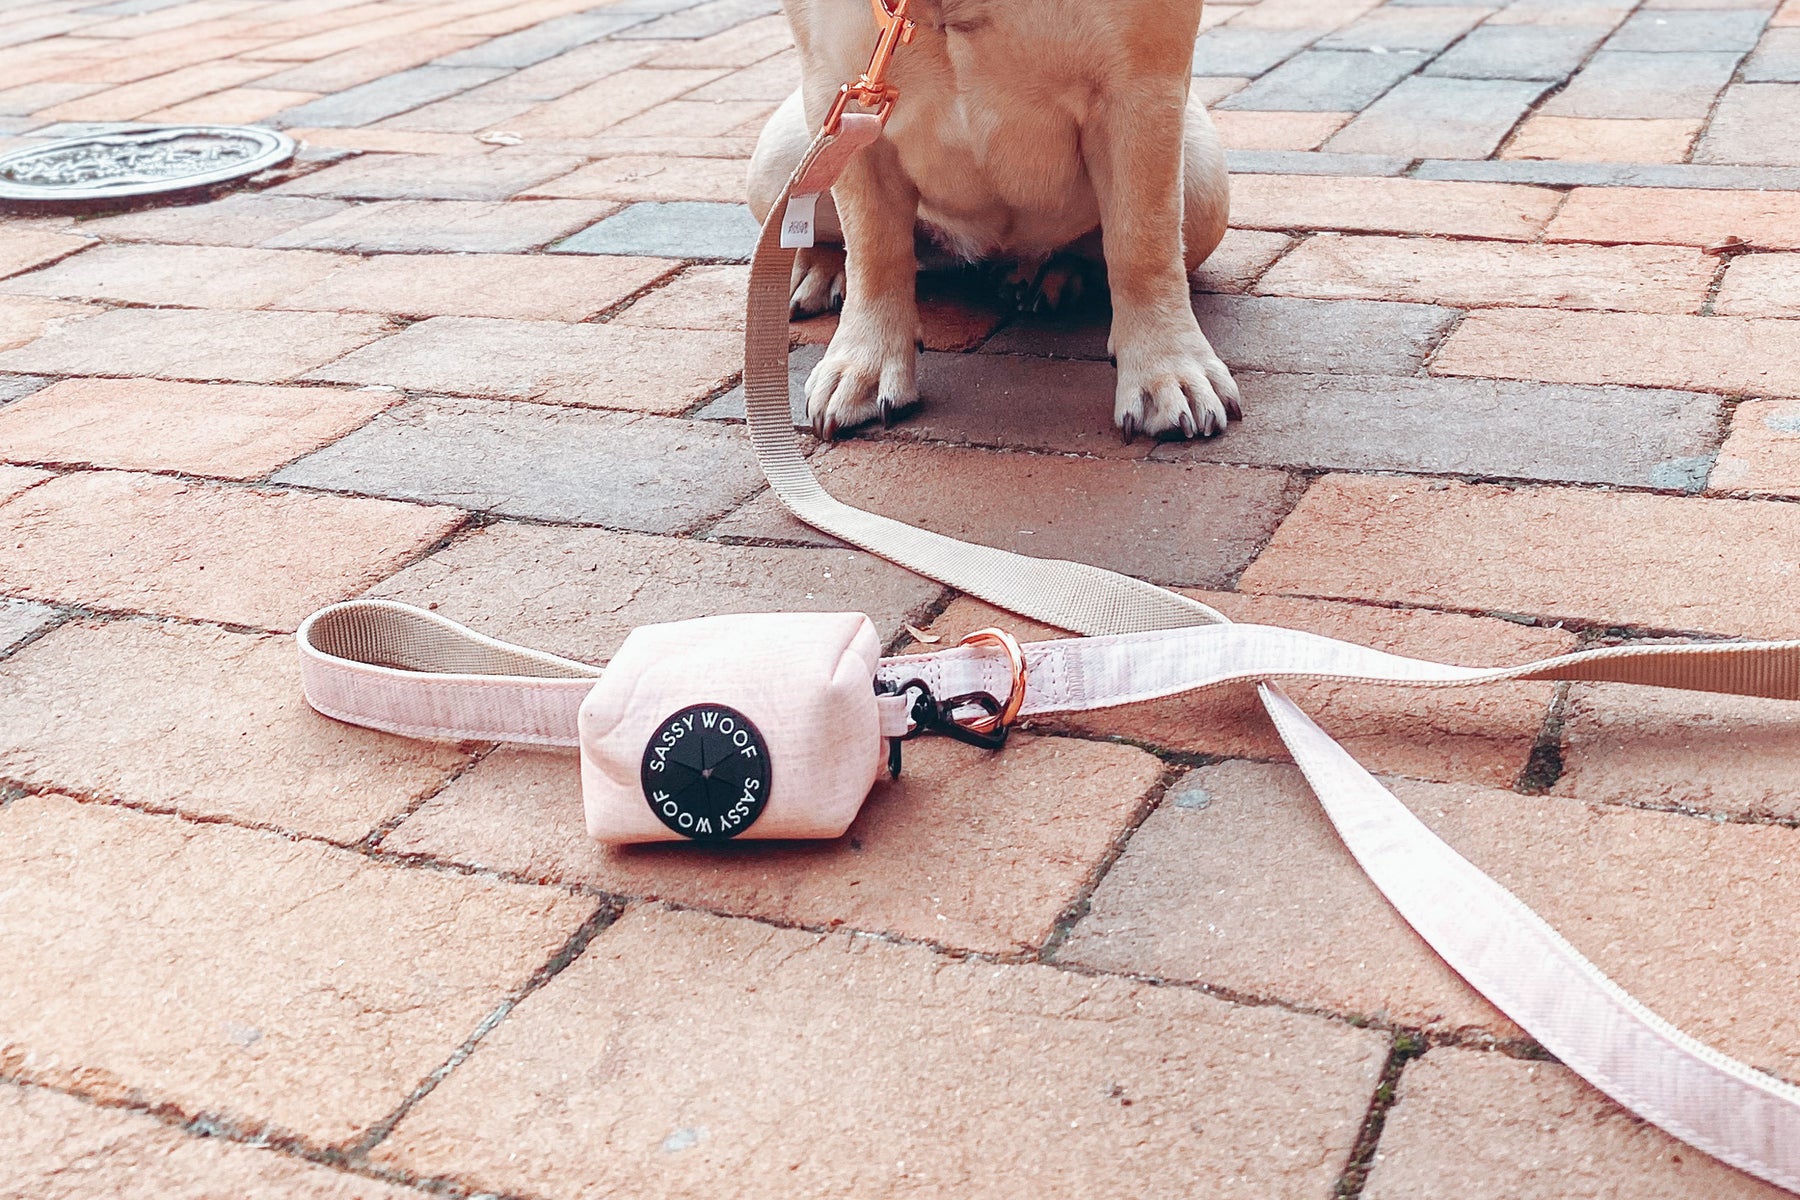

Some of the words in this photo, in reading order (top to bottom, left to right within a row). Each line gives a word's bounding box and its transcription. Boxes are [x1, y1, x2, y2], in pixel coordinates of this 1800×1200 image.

[650, 714, 694, 772] SASSY
[702, 711, 758, 759] WOOF
[653, 790, 713, 834] WOOF
[720, 777, 760, 832] SASSY
